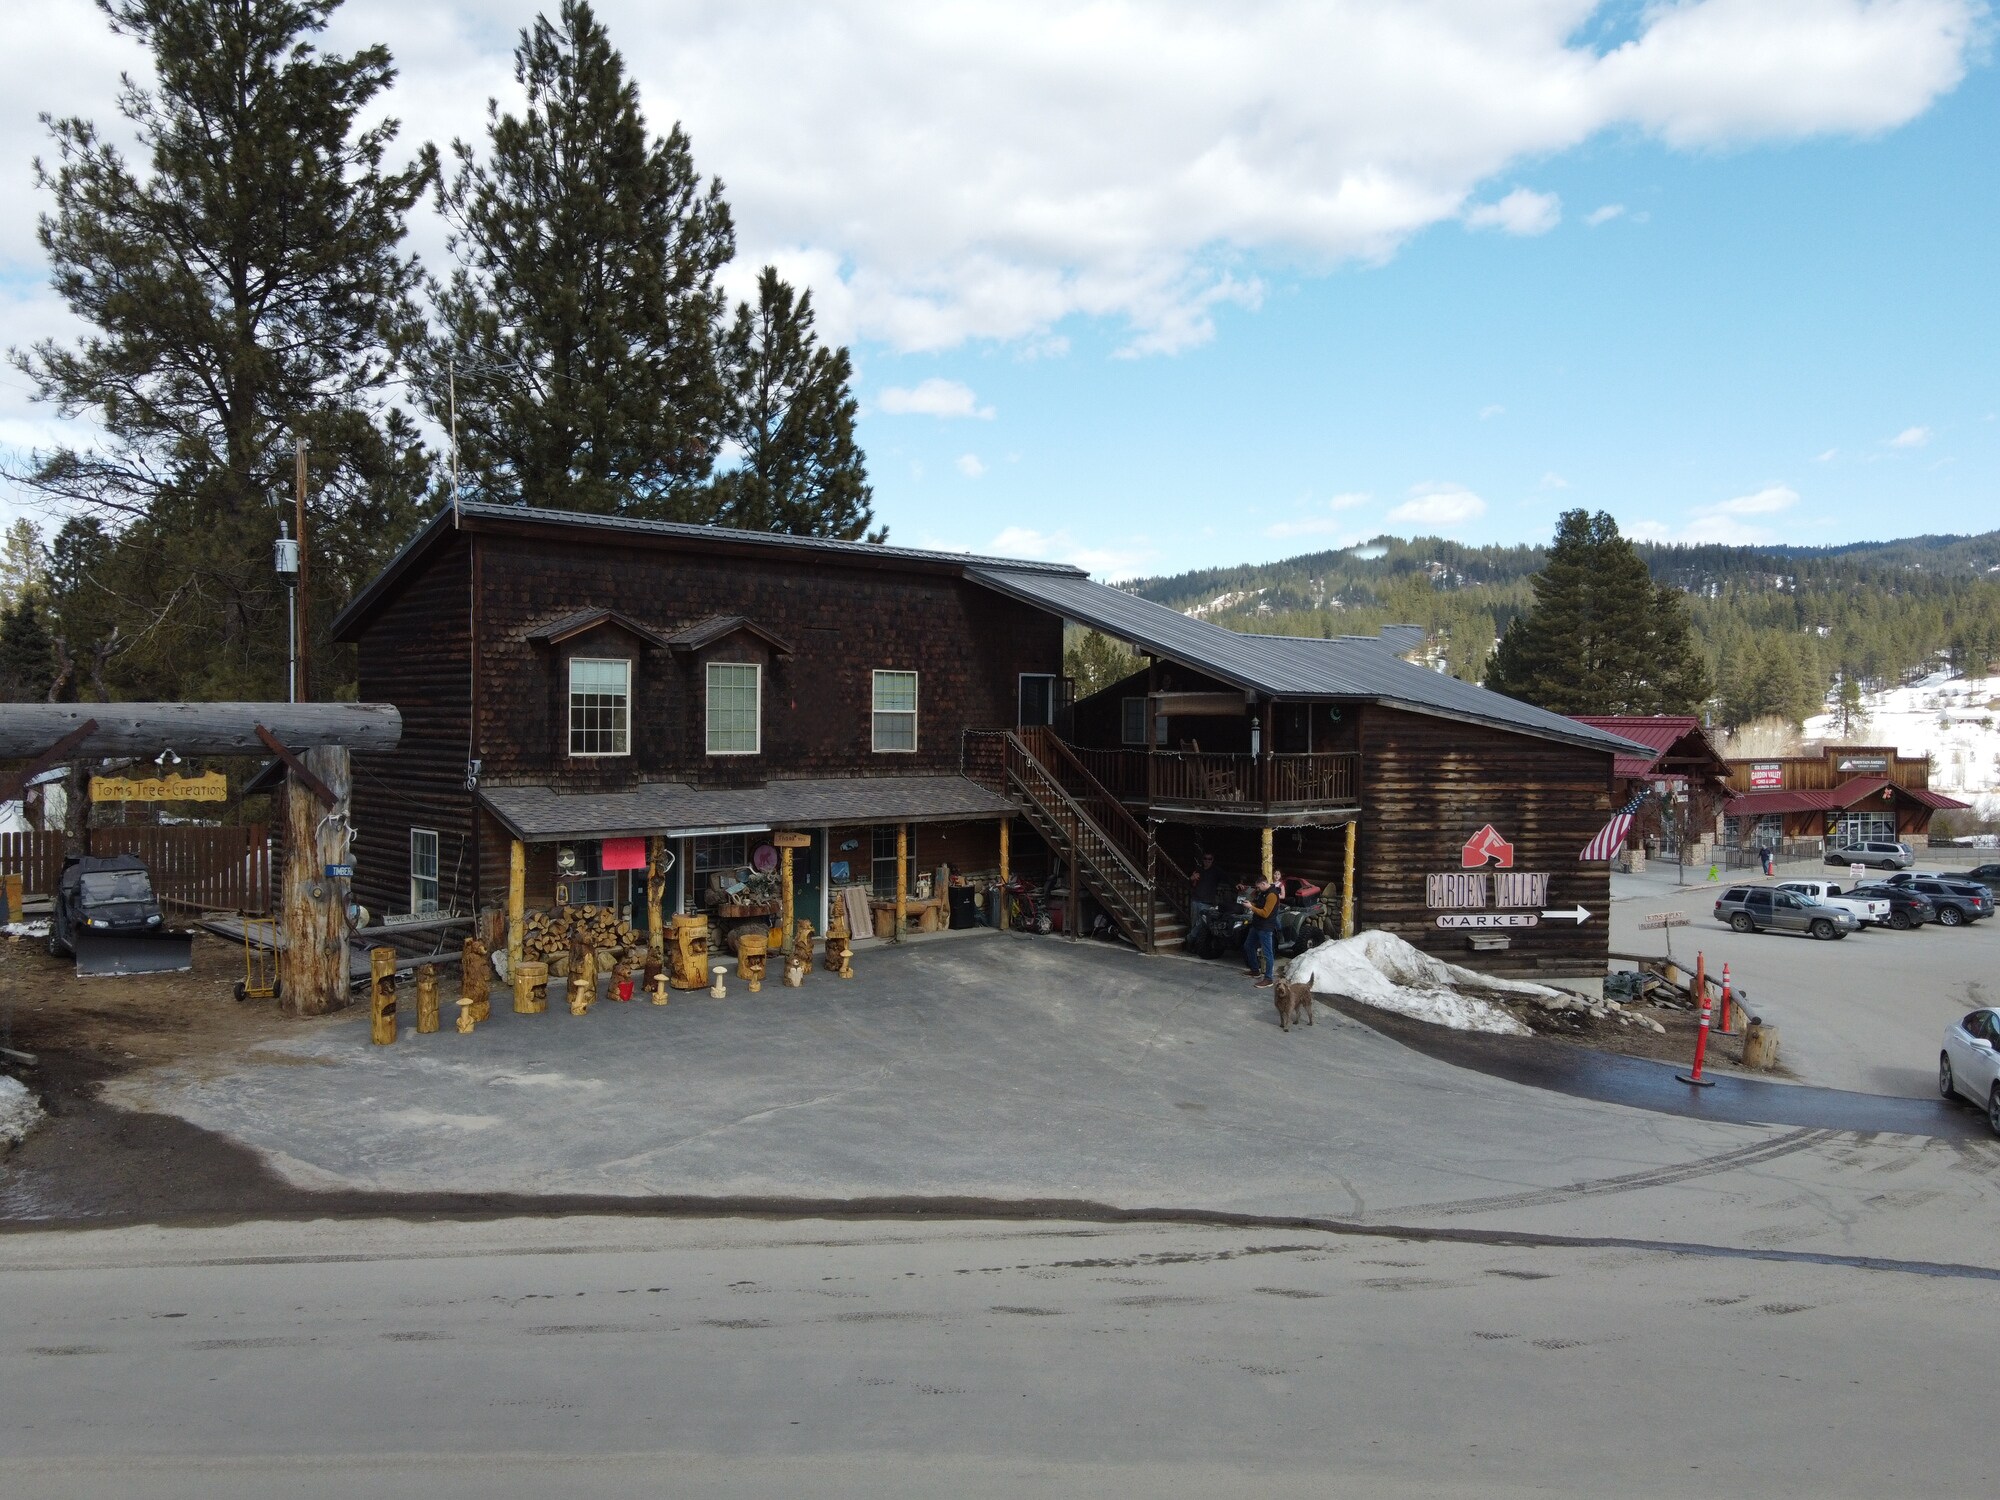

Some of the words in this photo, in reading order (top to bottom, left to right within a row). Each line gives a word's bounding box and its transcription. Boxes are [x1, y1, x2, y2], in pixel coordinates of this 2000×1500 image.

[1751, 770, 1768, 780] GARDEN
[1768, 771, 1782, 779] VALLEY
[95, 782, 132, 796] Toms
[1426, 873, 1487, 908] GARDEN
[1493, 873, 1550, 908] VALLEY
[1442, 916, 1533, 926] MARKET
